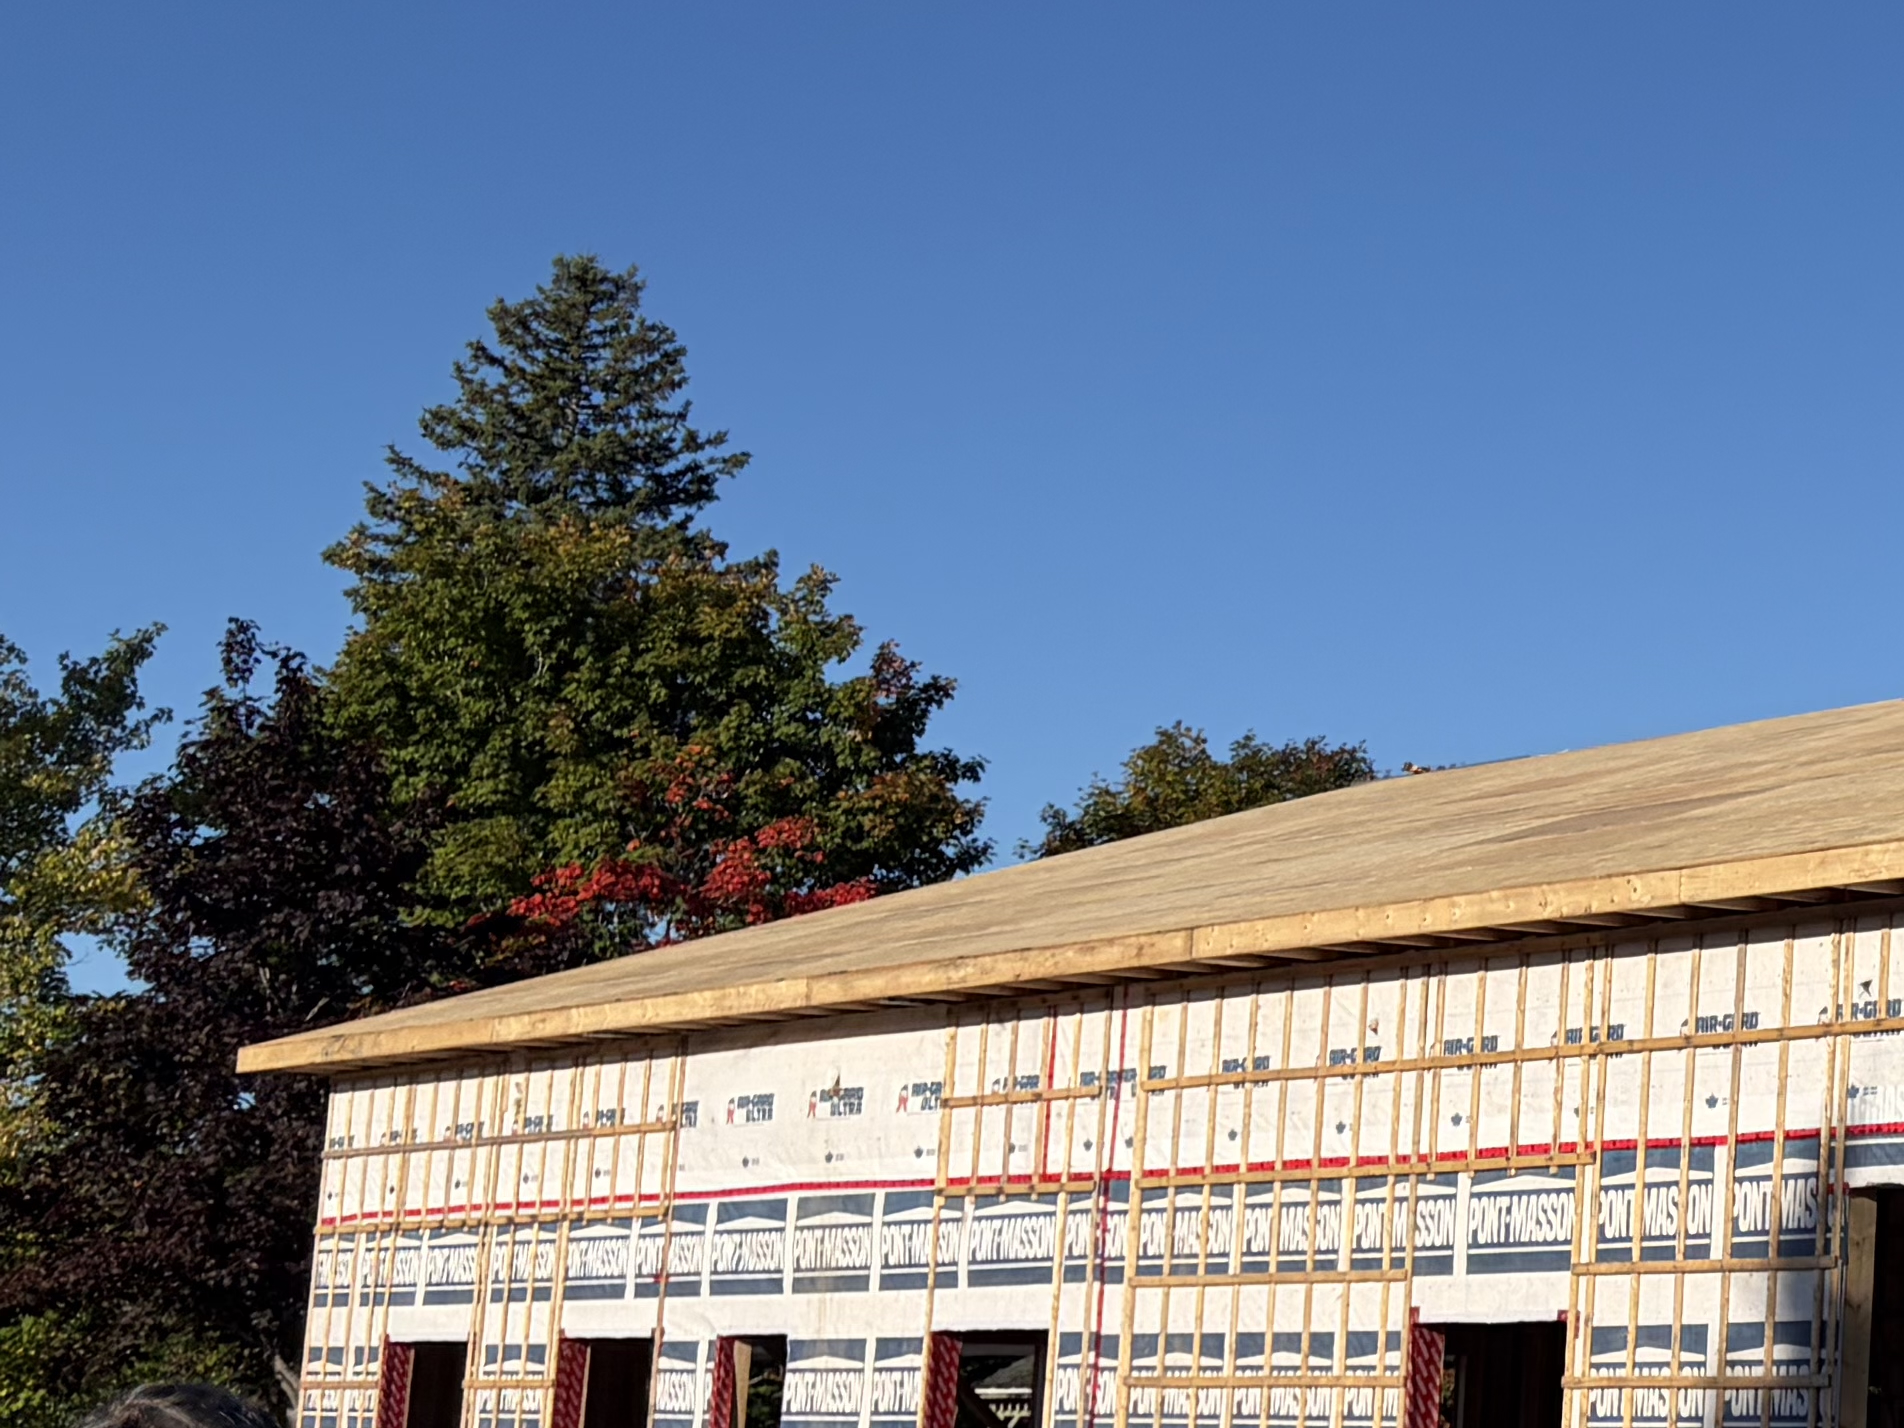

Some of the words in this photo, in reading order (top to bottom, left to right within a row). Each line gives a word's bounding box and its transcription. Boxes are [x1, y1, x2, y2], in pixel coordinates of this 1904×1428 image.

[567, 1238, 631, 1279] ONT-MASSON
[793, 1226, 872, 1271] PONT-MASSON
[968, 1217, 1056, 1263] PONT-MASSON
[784, 1372, 863, 1413] PONT-MASSON
